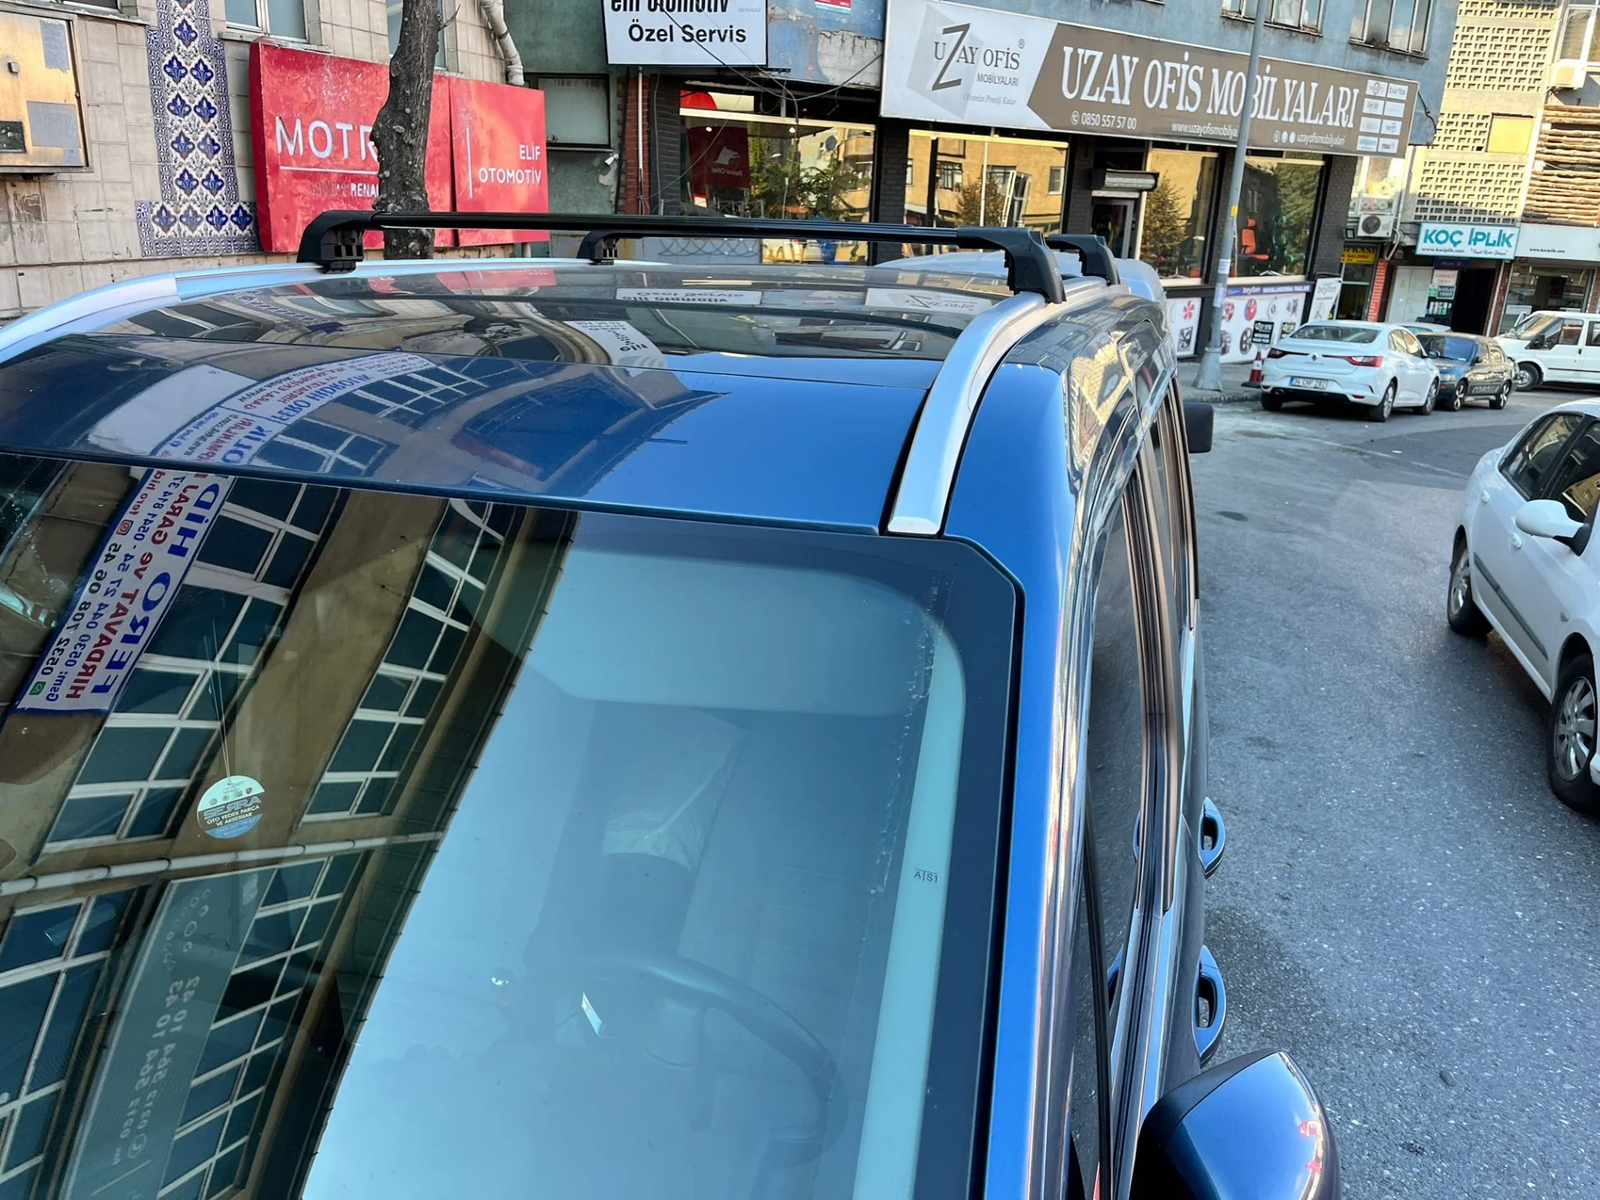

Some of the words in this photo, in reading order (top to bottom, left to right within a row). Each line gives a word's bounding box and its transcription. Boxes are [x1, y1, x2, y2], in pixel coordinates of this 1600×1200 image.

[628, 19, 673, 42] Özel
[682, 24, 747, 42] Servis
[932, 23, 979, 91] UZAY
[983, 47, 1020, 70] OFİS
[1061, 46, 1139, 105] UZAY
[1144, 51, 1204, 112] OFİS
[1206, 64, 1360, 128] MOBİLYALARI
[1081, 112, 1100, 126] 0850
[1101, 115, 1116, 128] 557
[1116, 116, 1127, 128] 57
[1126, 117, 1137, 130] 00
[276, 116, 378, 162] MOTR
[1171, 122, 1238, 139] www.uzayofismobilya.
[519, 144, 541, 160] ELİF
[478, 167, 541, 185] OTOMOTİV
[351, 183, 379, 198] RENA
[1423, 229, 1463, 247] KOÇ
[1467, 227, 1515, 248] İPLİK
[221, 810, 239, 820] YEDEK
